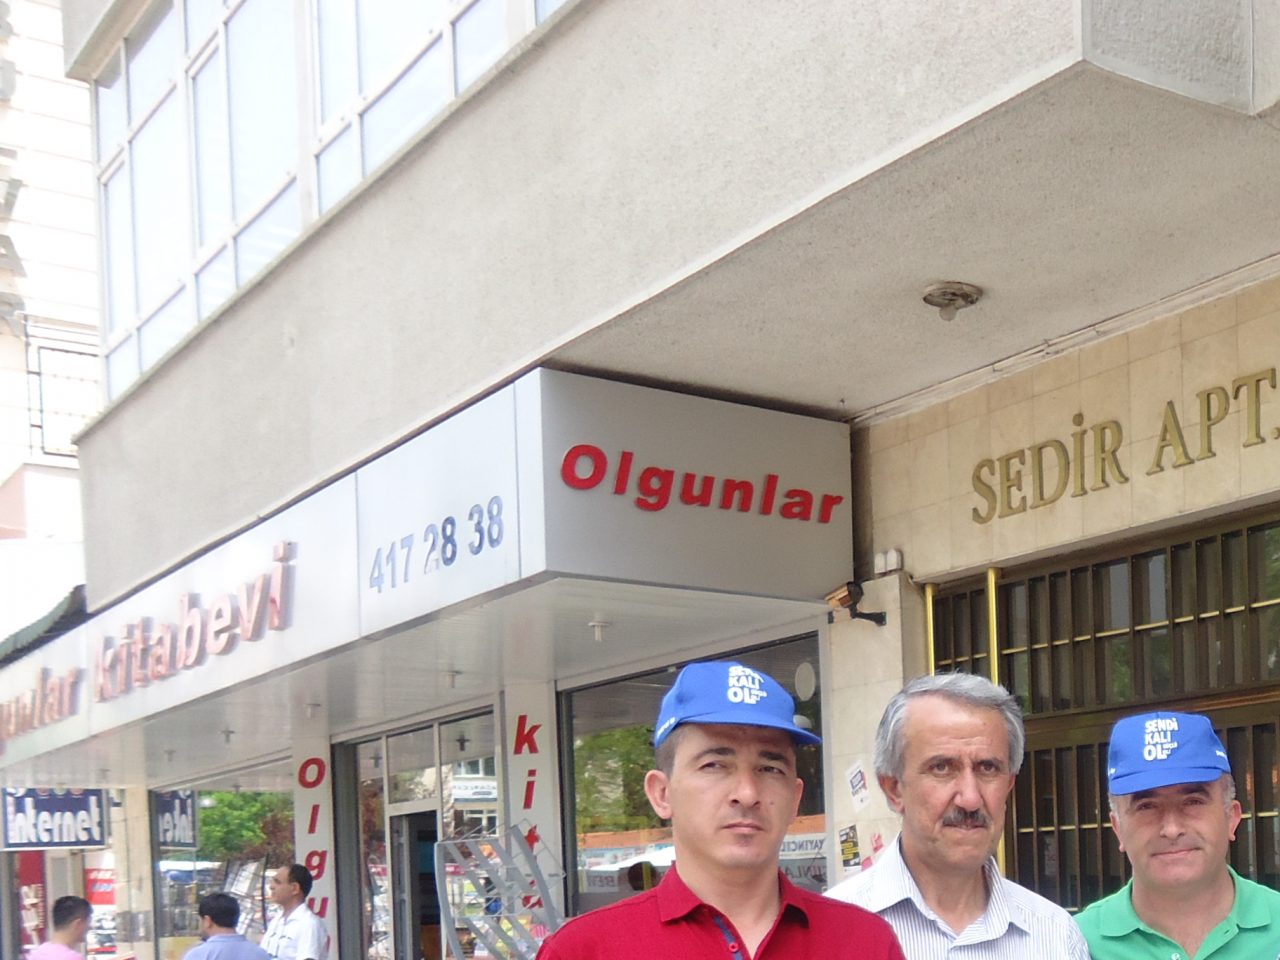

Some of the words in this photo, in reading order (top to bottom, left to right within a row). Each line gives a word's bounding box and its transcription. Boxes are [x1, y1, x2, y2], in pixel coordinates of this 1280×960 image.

[560, 444, 844, 524] Olgunlar
[972, 412, 1129, 525] SEDİR
[369, 533, 415, 594] 417
[423, 515, 457, 575] 28
[468, 495, 504, 556] 38
[0, 667, 84, 756] unlar
[96, 541, 298, 704] kitabevi
